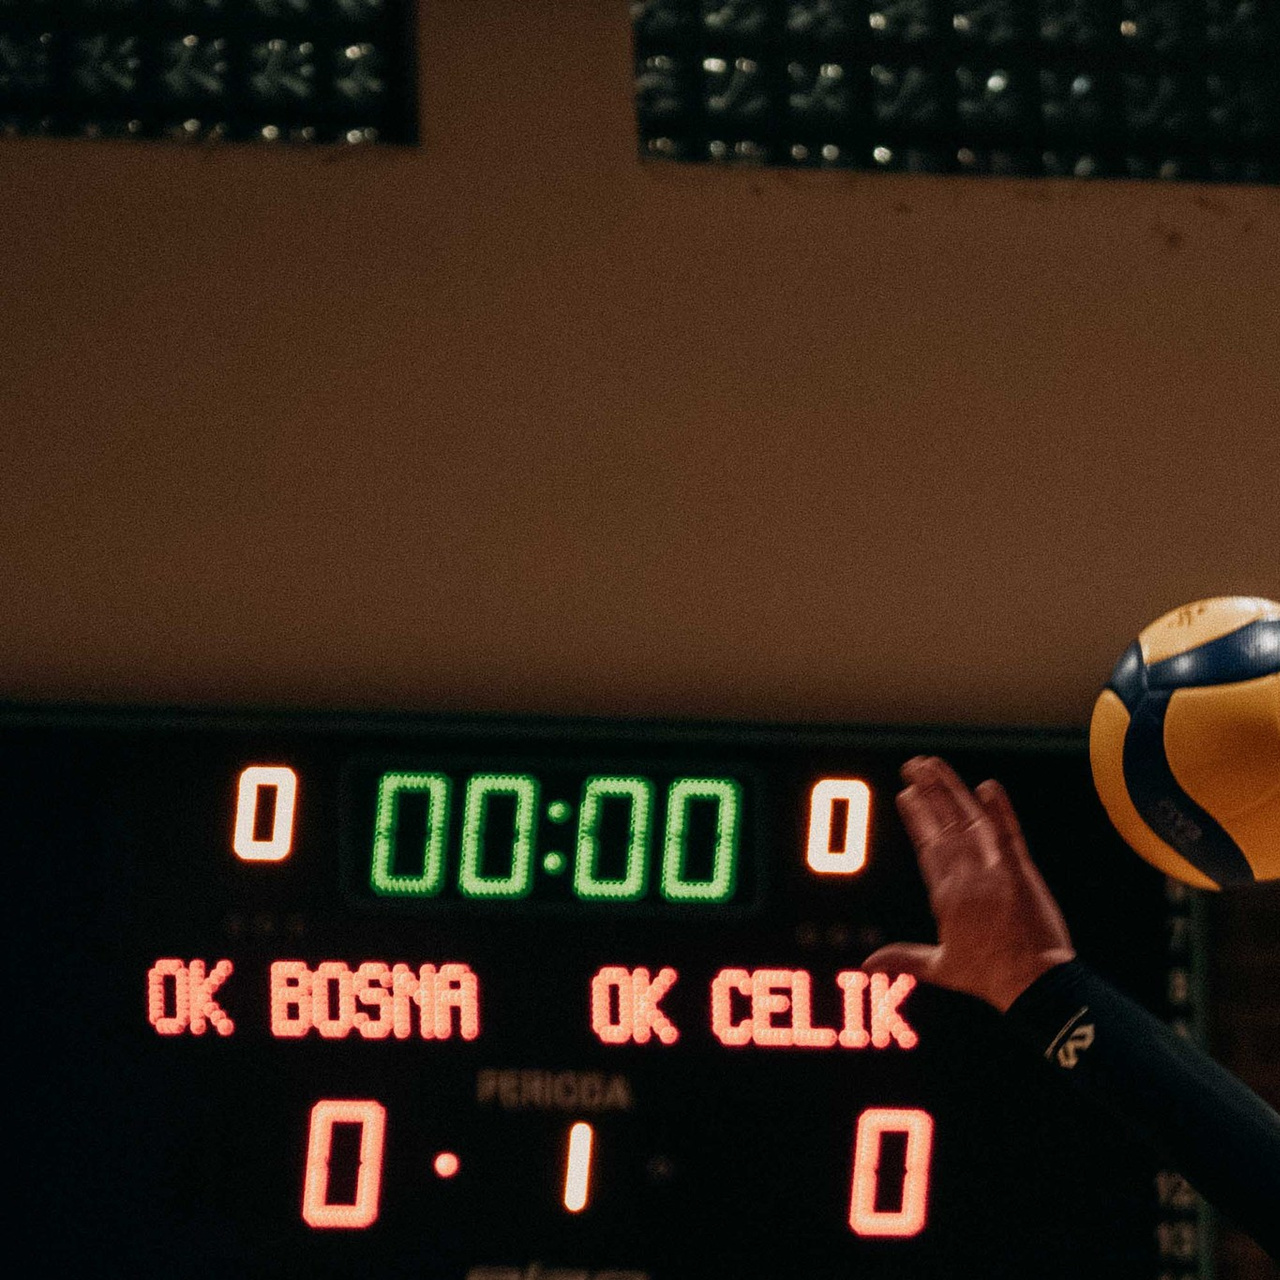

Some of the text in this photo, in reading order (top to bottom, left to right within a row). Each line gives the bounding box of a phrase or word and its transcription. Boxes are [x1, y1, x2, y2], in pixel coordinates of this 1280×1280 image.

[231, 764, 300, 864] 0
[370, 772, 739, 901] 00:00
[804, 776, 873, 877] 0
[146, 957, 481, 1042] OK BOSNA
[590, 965, 918, 1050] OK CELIK
[301, 1098, 387, 1230] 0
[562, 1121, 595, 1214] 1
[847, 1106, 935, 1238] 0
